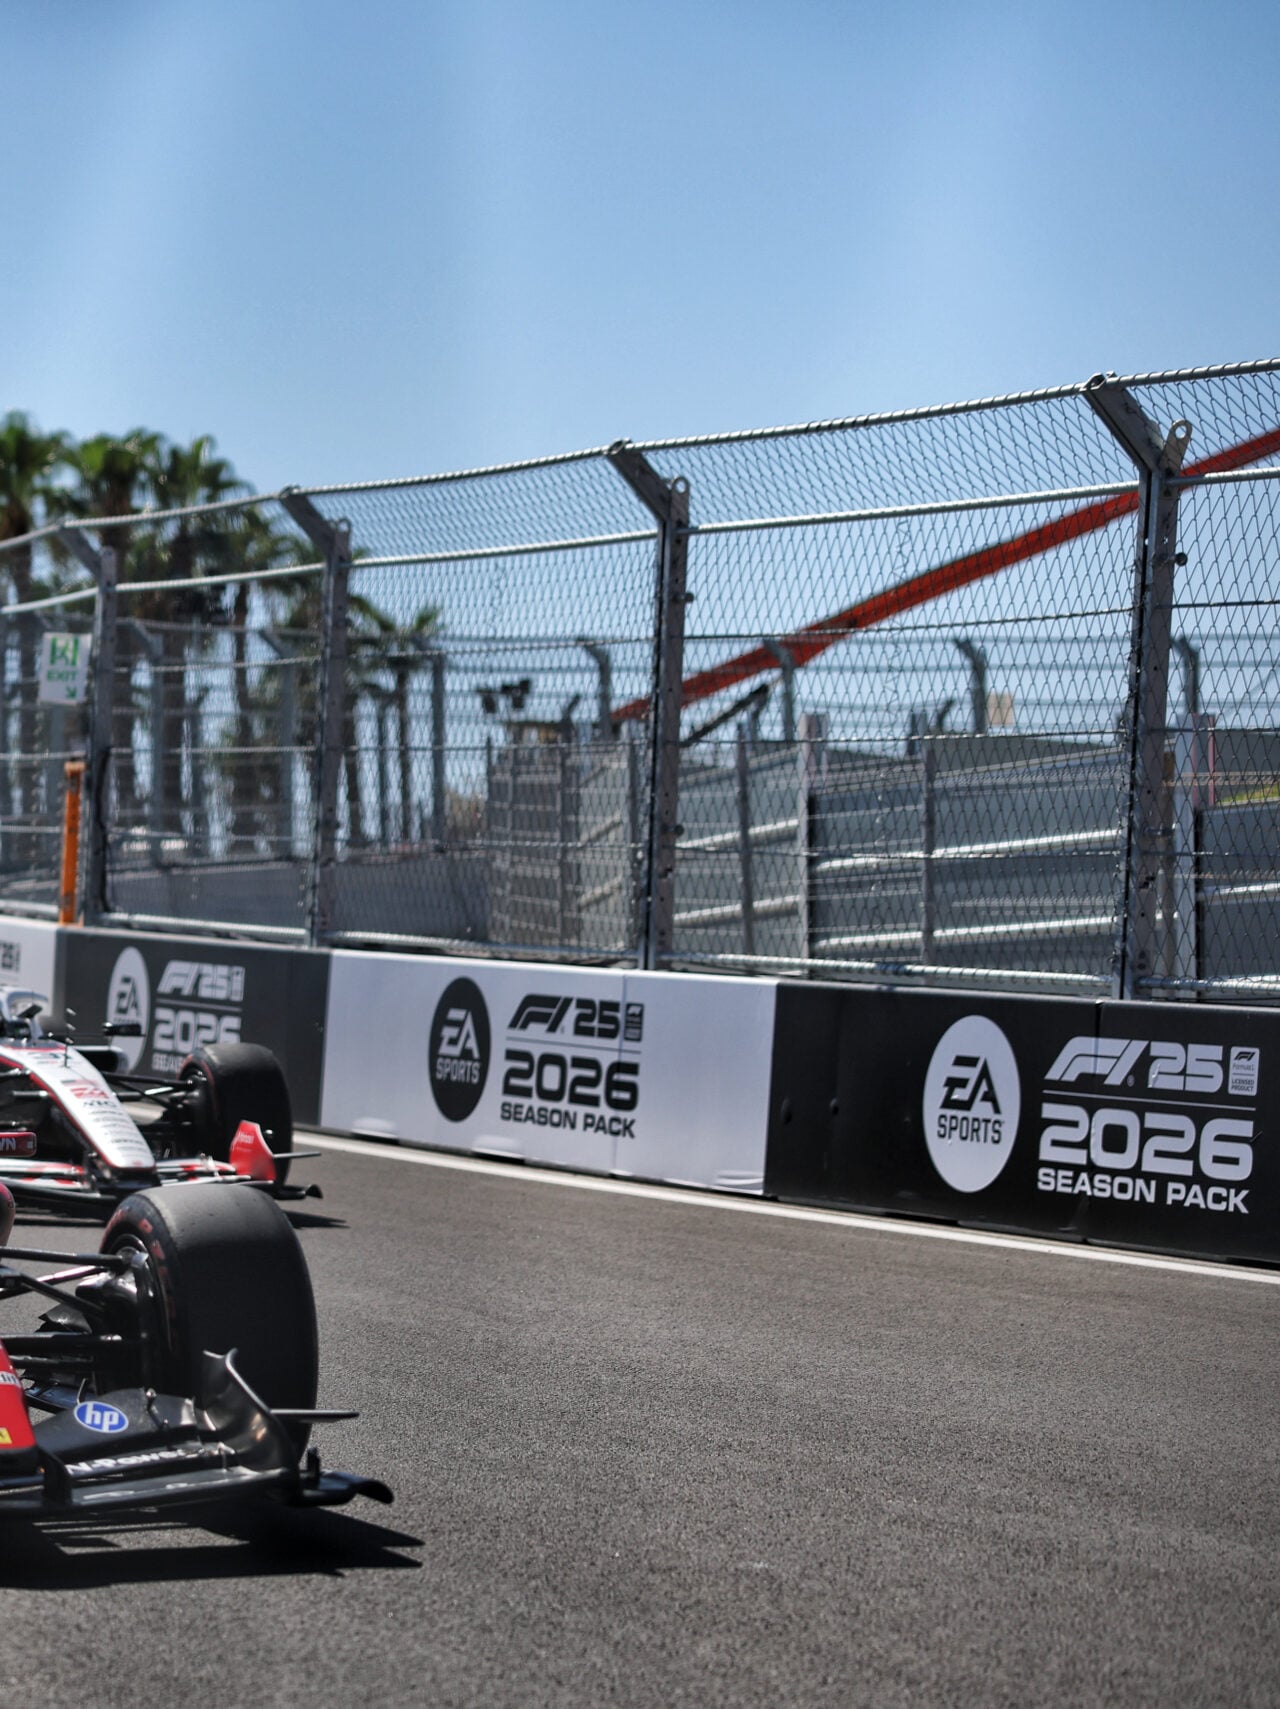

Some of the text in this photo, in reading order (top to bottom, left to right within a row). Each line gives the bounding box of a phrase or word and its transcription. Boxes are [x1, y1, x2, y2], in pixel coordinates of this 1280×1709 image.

[439, 1008, 480, 1060] EA
[573, 998, 621, 1040] 25
[436, 1057, 481, 1084] SPORTS
[501, 1048, 640, 1112] 2026
[940, 1055, 1002, 1115] EA
[1147, 1041, 1224, 1093] 25
[500, 1102, 636, 1139] SEASON PACK
[937, 1114, 1004, 1145] SPORTS
[1039, 1102, 1255, 1181] 2026
[1037, 1167, 1249, 1215] SEASON PACK
[85, 1404, 120, 1432] hp
